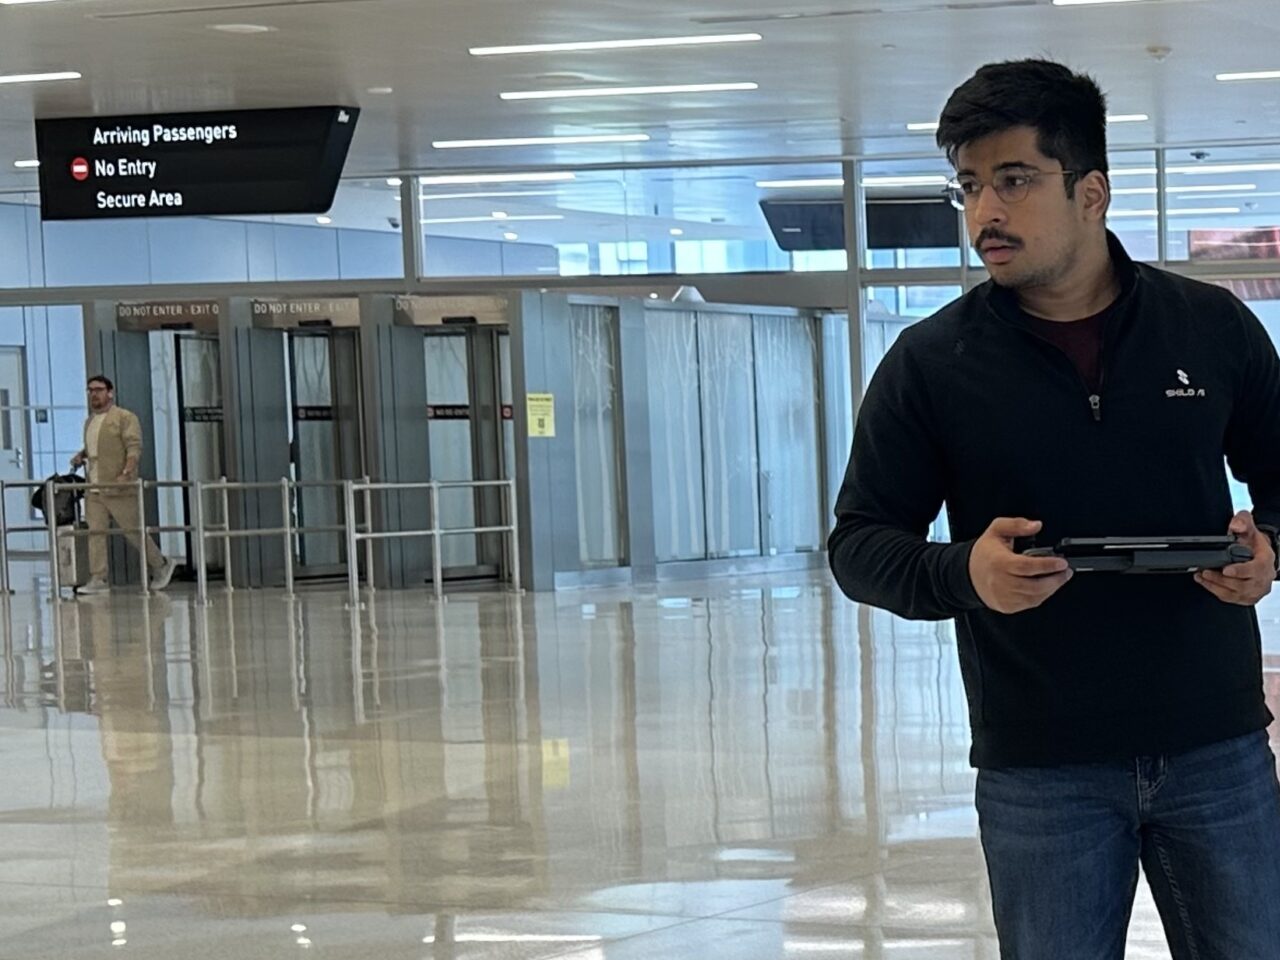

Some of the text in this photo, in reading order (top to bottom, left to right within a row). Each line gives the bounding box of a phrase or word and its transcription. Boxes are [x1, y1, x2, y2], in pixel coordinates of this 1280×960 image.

[93, 124, 237, 146] Arriving Passengers
[94, 159, 156, 179] No Entry
[96, 190, 183, 209] Secure Area
[119, 307, 132, 317] DO
[133, 306, 150, 316] NOT
[153, 305, 183, 316] ENTER
[190, 304, 210, 315] EXIT
[254, 303, 267, 314] DO
[269, 302, 287, 314] NOT
[289, 301, 321, 313] ENTER
